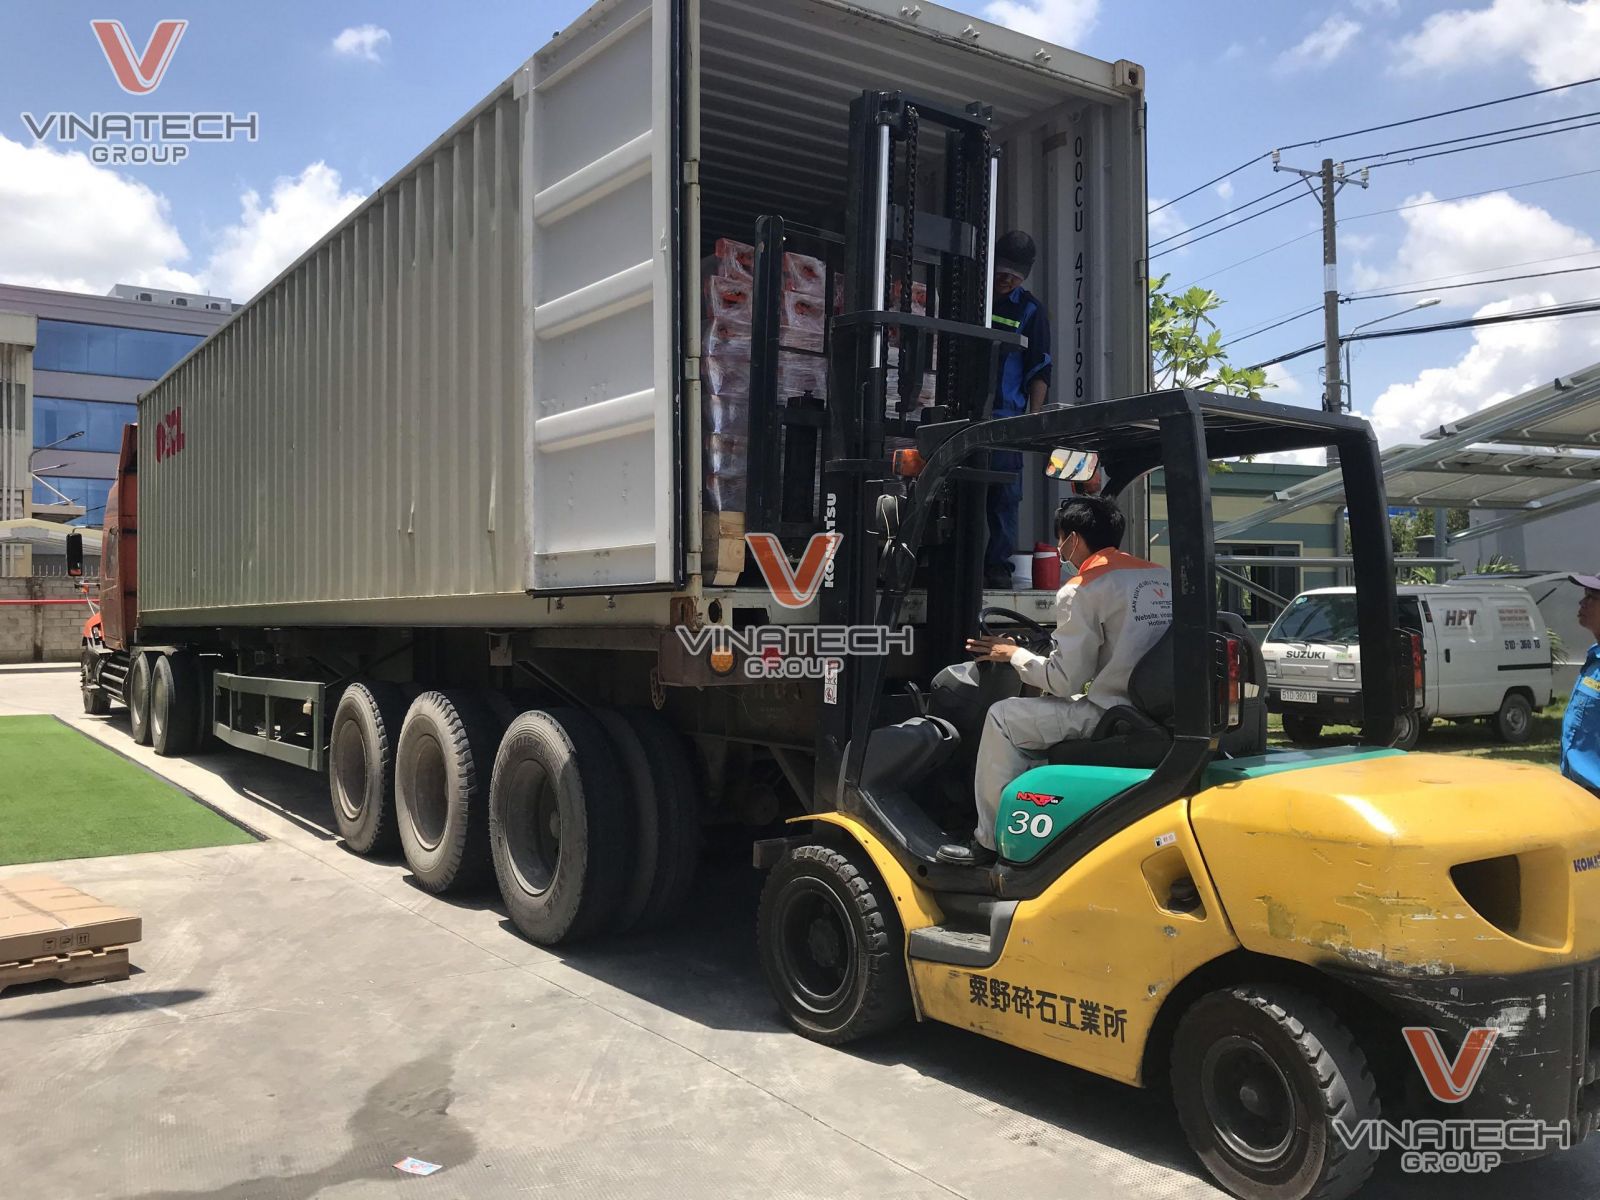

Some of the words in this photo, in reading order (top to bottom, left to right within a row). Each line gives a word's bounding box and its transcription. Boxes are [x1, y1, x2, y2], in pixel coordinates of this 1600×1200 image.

[1074, 252, 1084, 398] 472198
[823, 492, 837, 588] KOMATSU
[1445, 610, 1477, 626] HPT
[1286, 650, 1326, 659] SUZUKI
[1007, 810, 1053, 838] 30
[969, 974, 1128, 1043] 粟野砕石工業所
